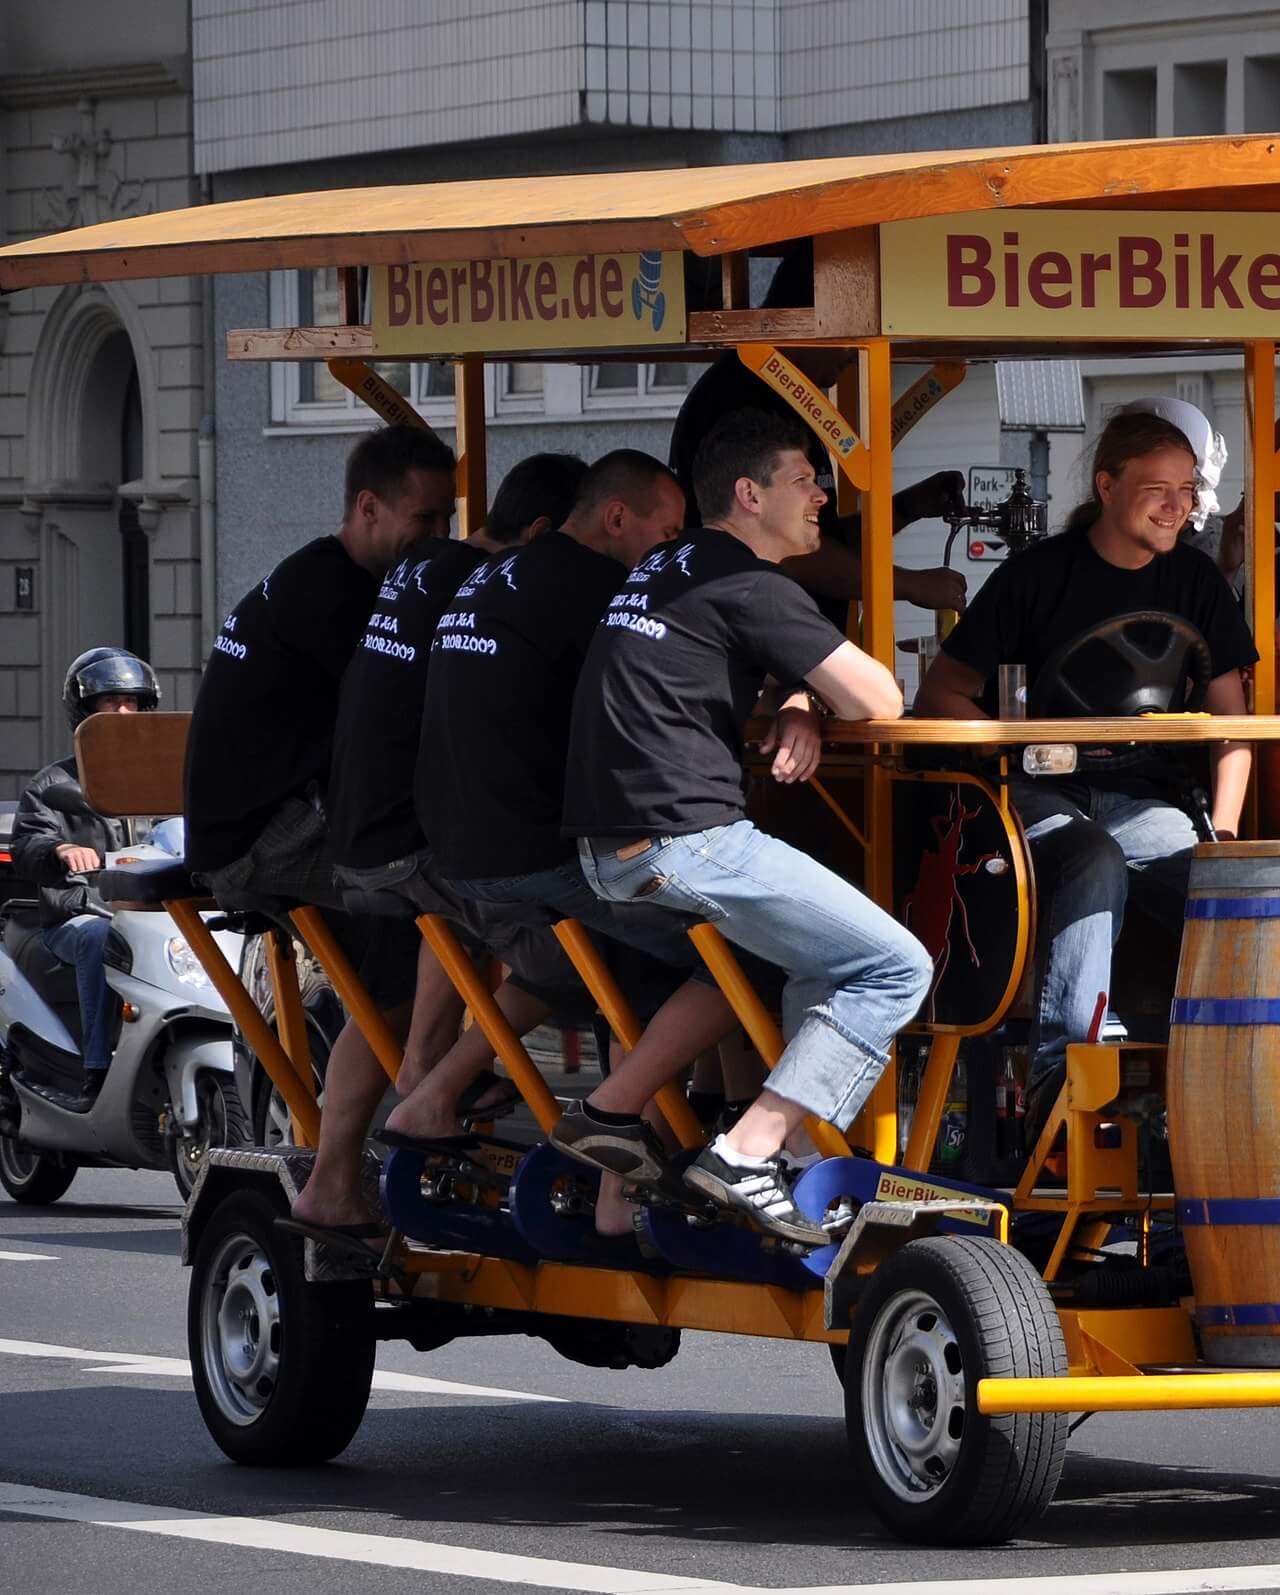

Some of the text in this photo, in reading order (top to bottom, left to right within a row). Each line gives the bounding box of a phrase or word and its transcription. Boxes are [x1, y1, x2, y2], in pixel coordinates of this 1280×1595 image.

[387, 254, 625, 327] BierBike.de
[363, 377, 410, 424] BierBik
[766, 357, 842, 440] BierBike.de
[891, 391, 931, 435] ike.de
[973, 476, 1005, 492] Park-
